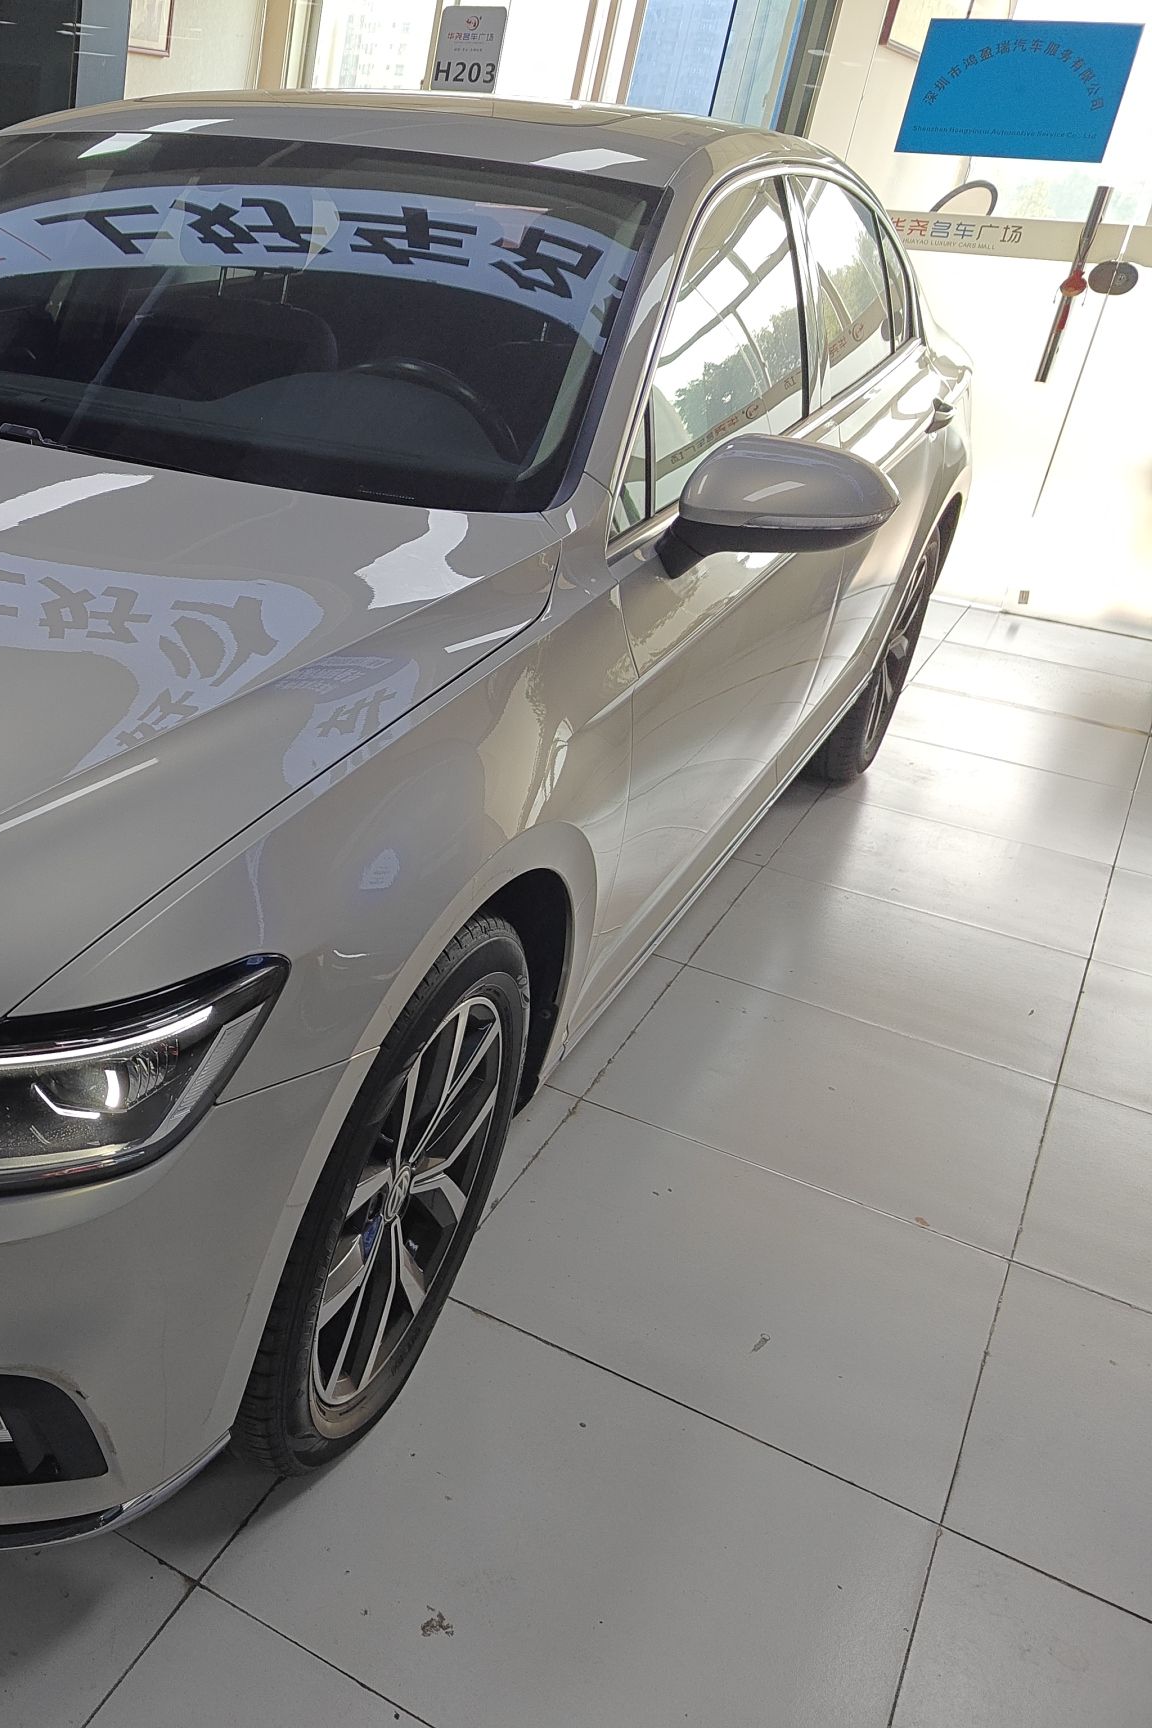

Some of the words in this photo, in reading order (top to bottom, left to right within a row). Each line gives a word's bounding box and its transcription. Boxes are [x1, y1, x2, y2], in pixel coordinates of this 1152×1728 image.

[434, 61, 496, 84] H203
[922, 38, 1104, 112] 深圳市鸿盈瑞汽车服务有限公司
[890, 217, 1024, 244] 华尧名车广场
[930, 240, 957, 248] LUXURY
